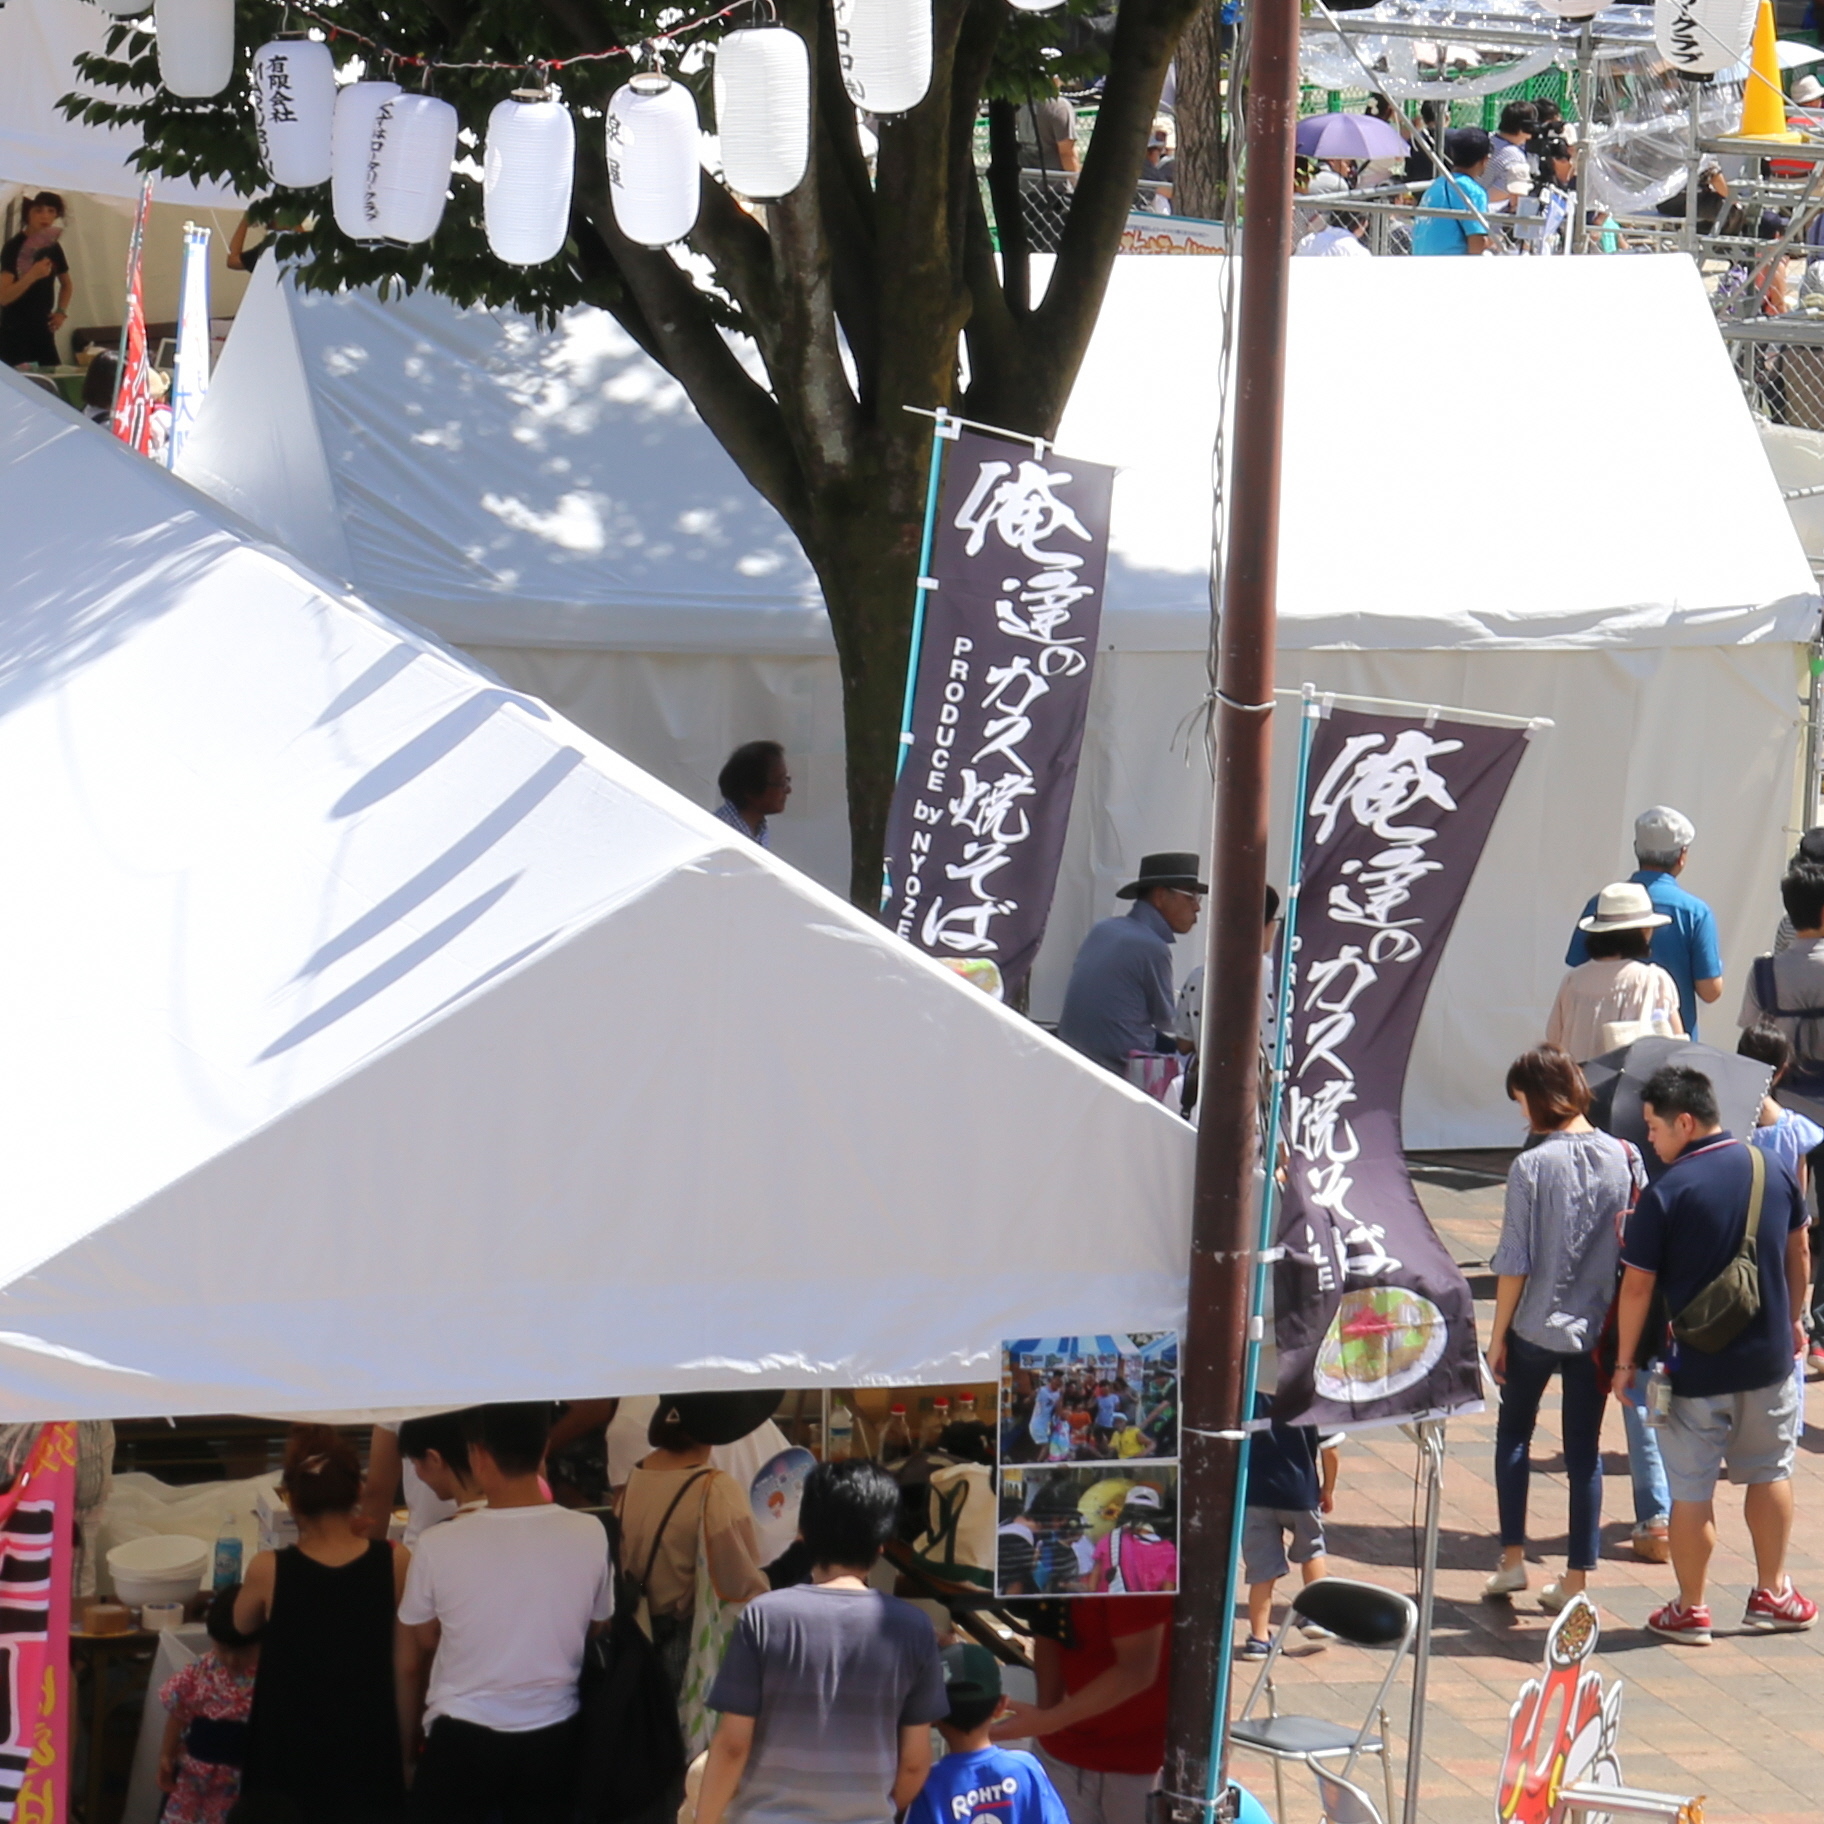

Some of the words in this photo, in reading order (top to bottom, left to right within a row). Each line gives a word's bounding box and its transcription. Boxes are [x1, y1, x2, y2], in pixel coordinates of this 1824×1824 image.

[266, 56, 299, 125] 有限会社
[926, 636, 973, 793] PRODUCE
[912, 798, 944, 826] by
[896, 831, 932, 941] NYOZE
[951, 1776, 1019, 1821] ROHTO
